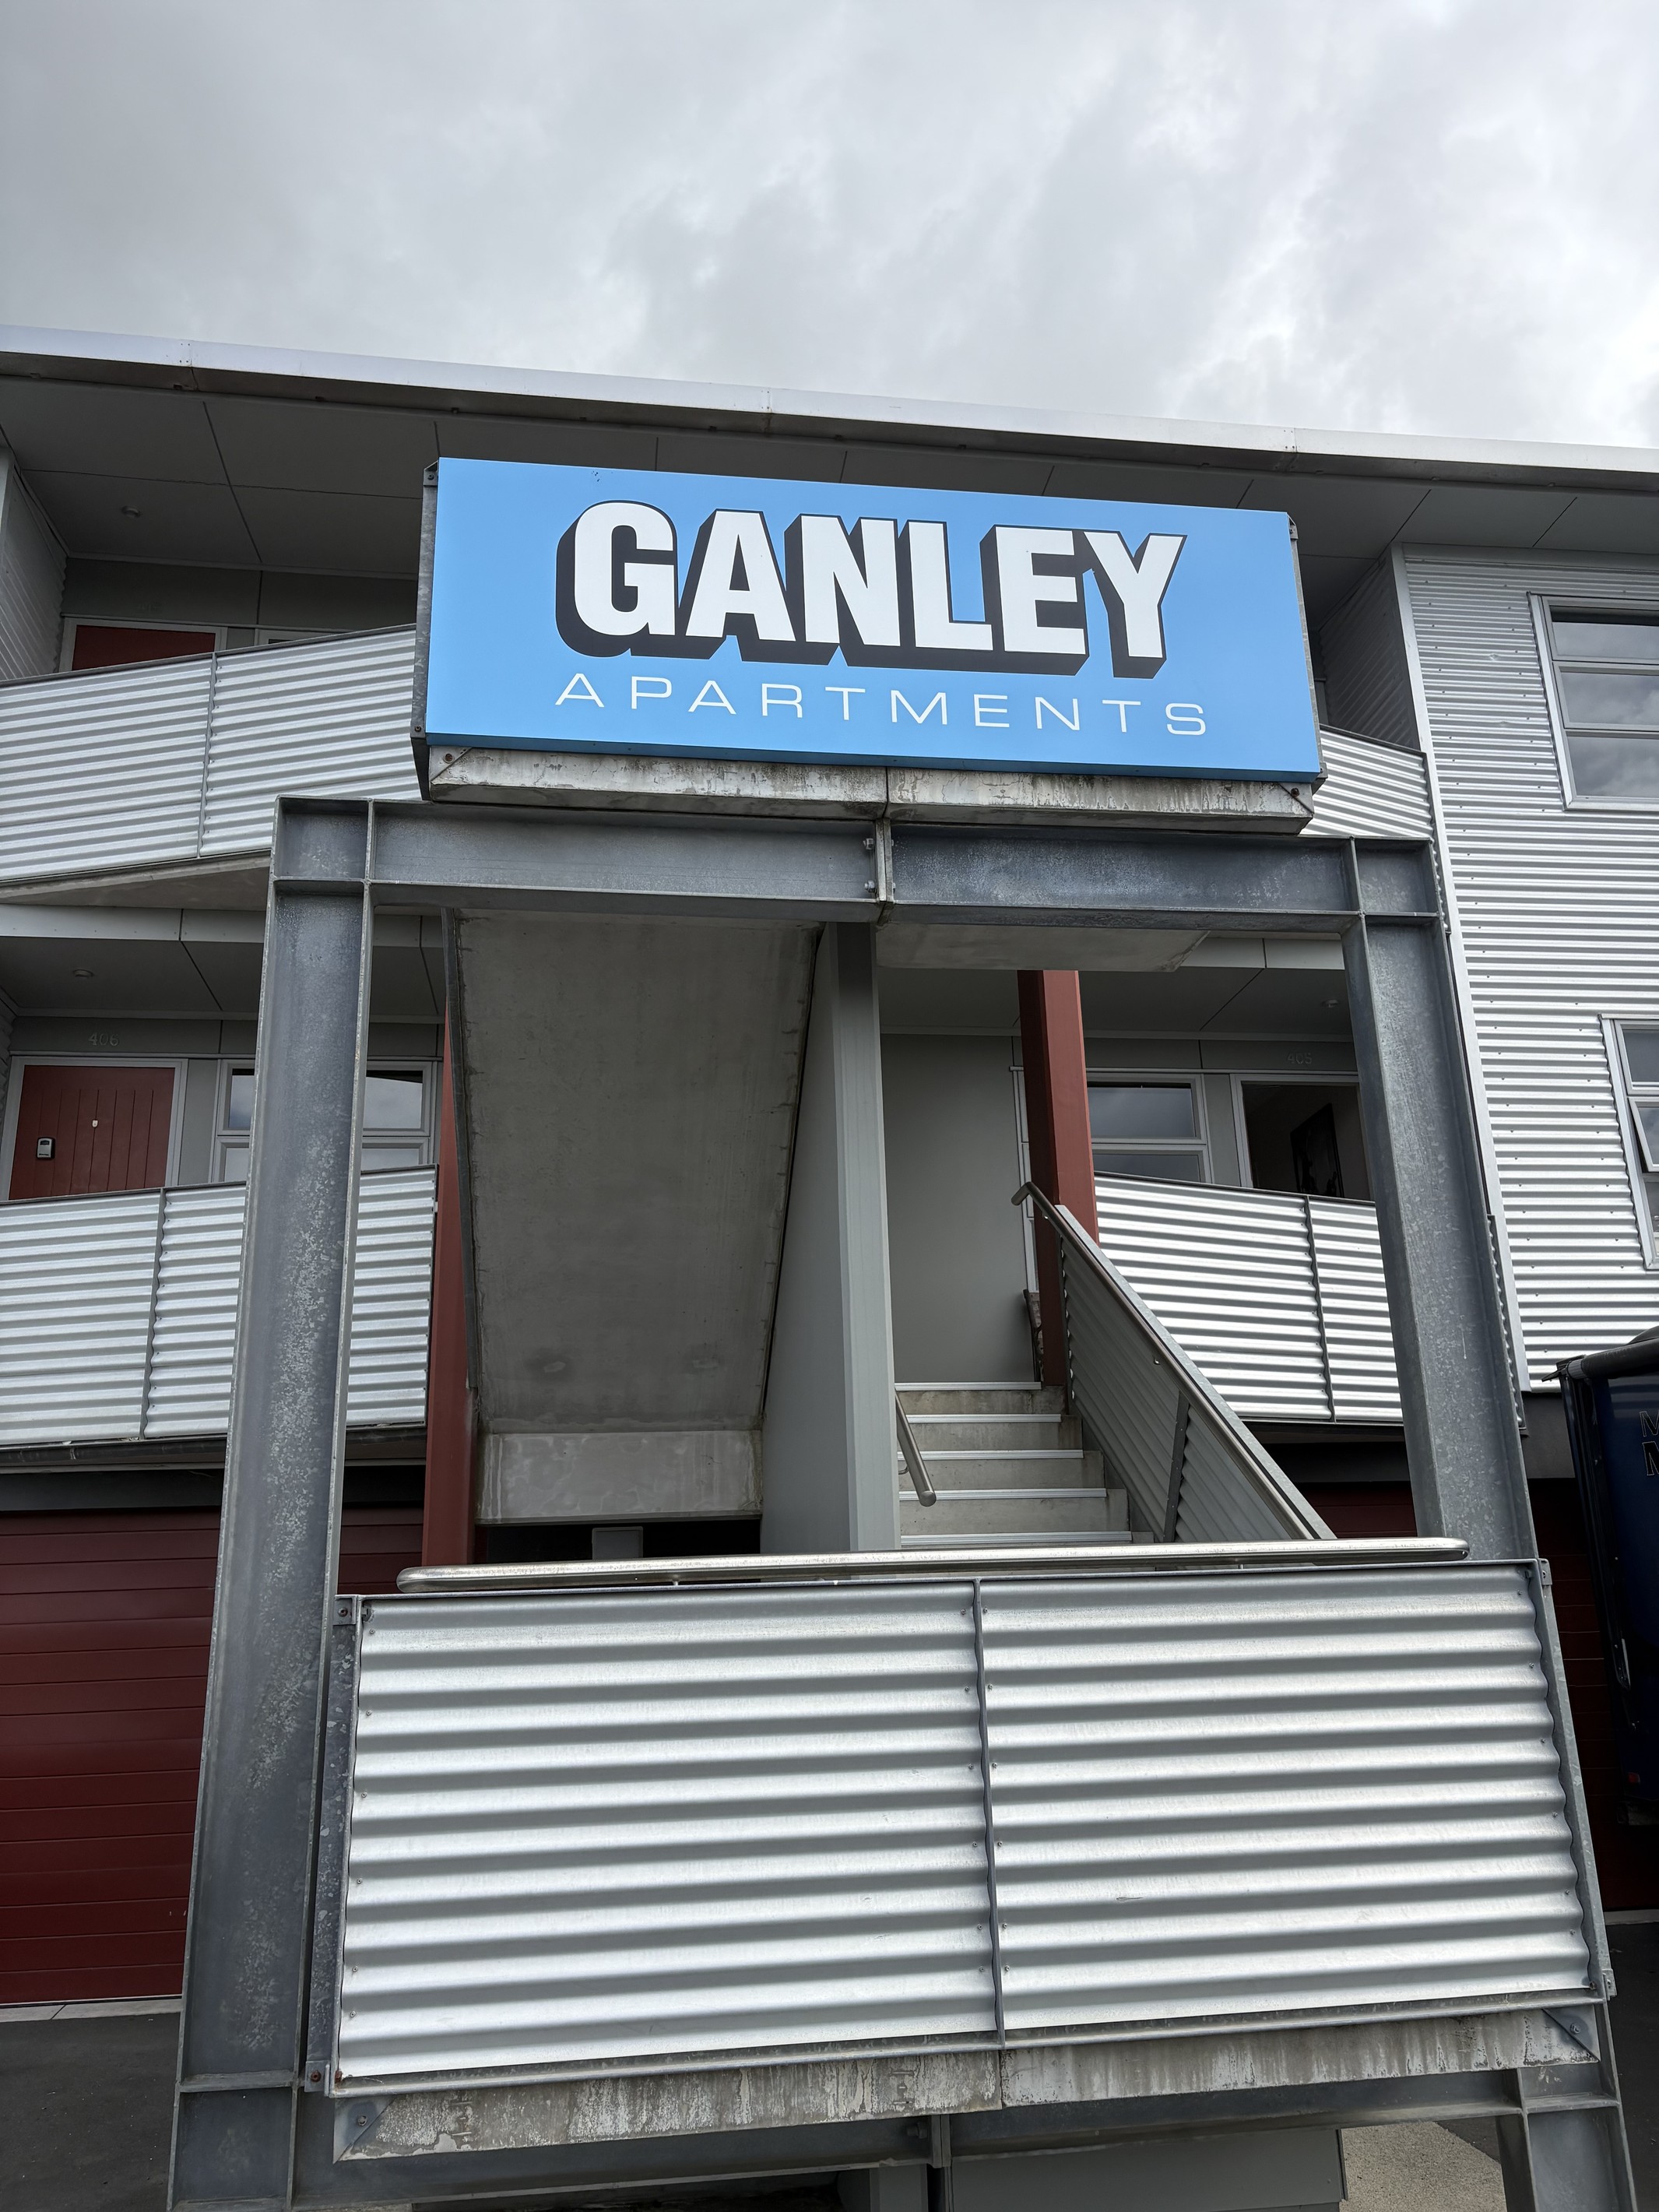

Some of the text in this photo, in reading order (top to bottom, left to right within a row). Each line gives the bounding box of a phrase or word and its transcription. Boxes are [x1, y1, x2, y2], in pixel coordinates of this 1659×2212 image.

[557, 501, 1187, 677] GANLEY
[555, 673, 1207, 736] APARTMENTS
[88, 1032, 119, 1046] 406
